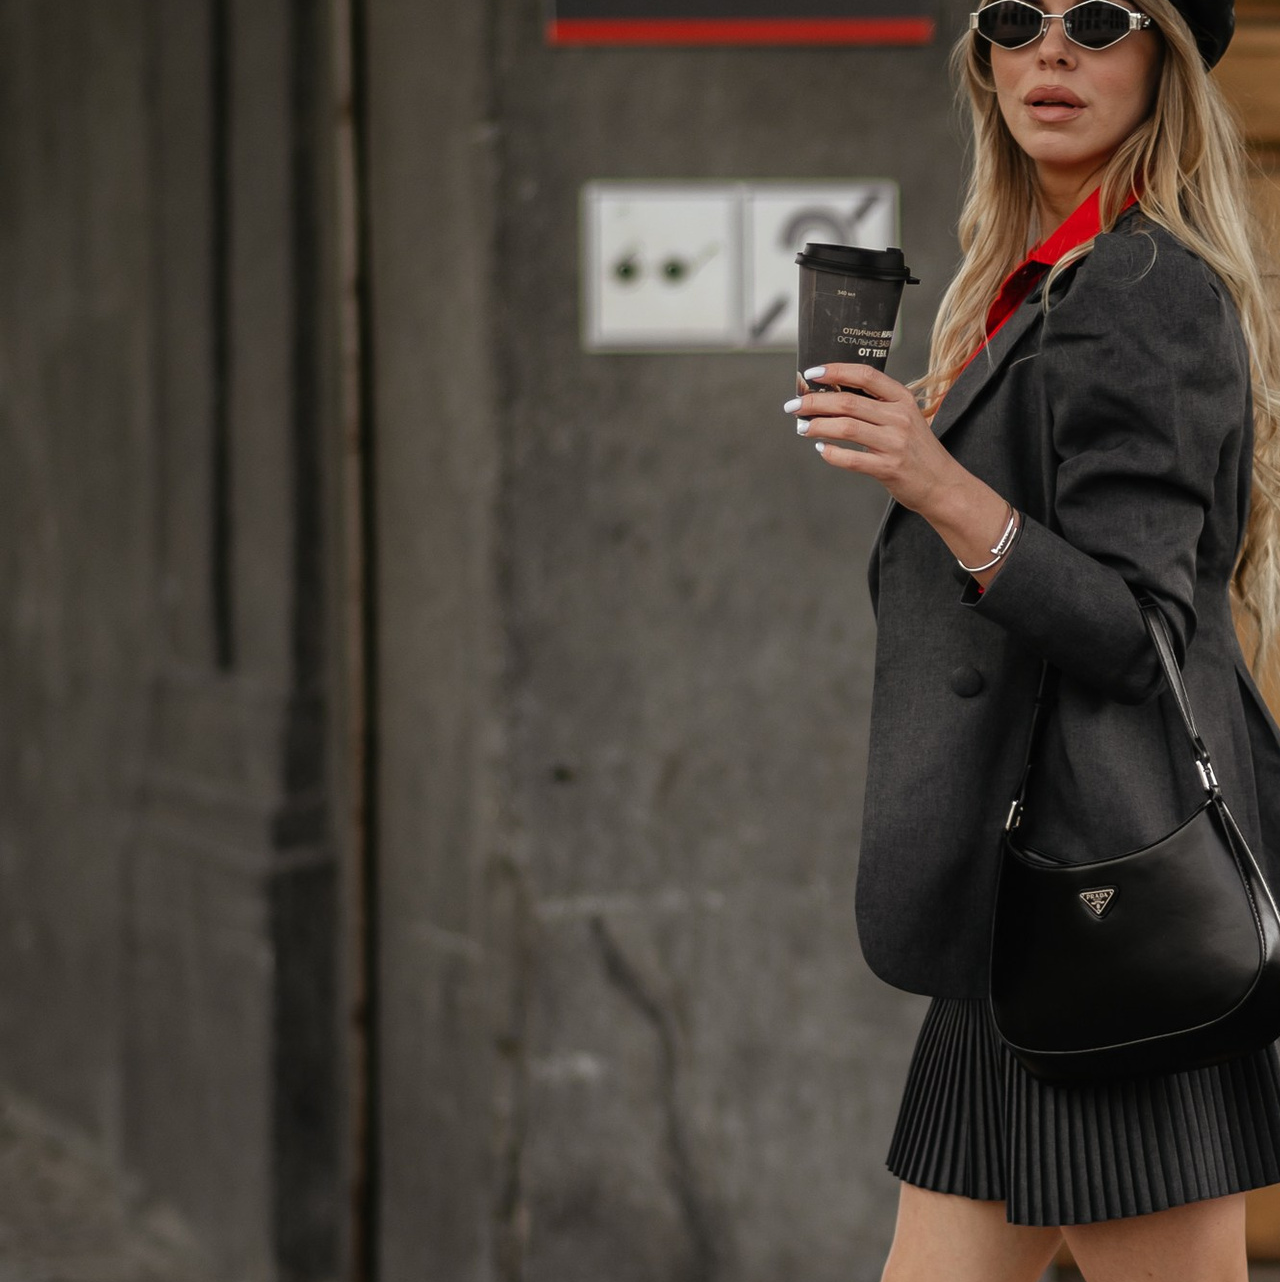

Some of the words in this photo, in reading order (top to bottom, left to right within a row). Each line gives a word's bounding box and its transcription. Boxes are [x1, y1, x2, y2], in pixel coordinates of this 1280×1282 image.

[843, 327, 881, 338] ОТЛИЧНОЕ
[837, 335, 879, 347] ОСТАЛЬНОЕ
[858, 348, 871, 357] ОТ
[1086, 892, 1108, 900] PRADA
